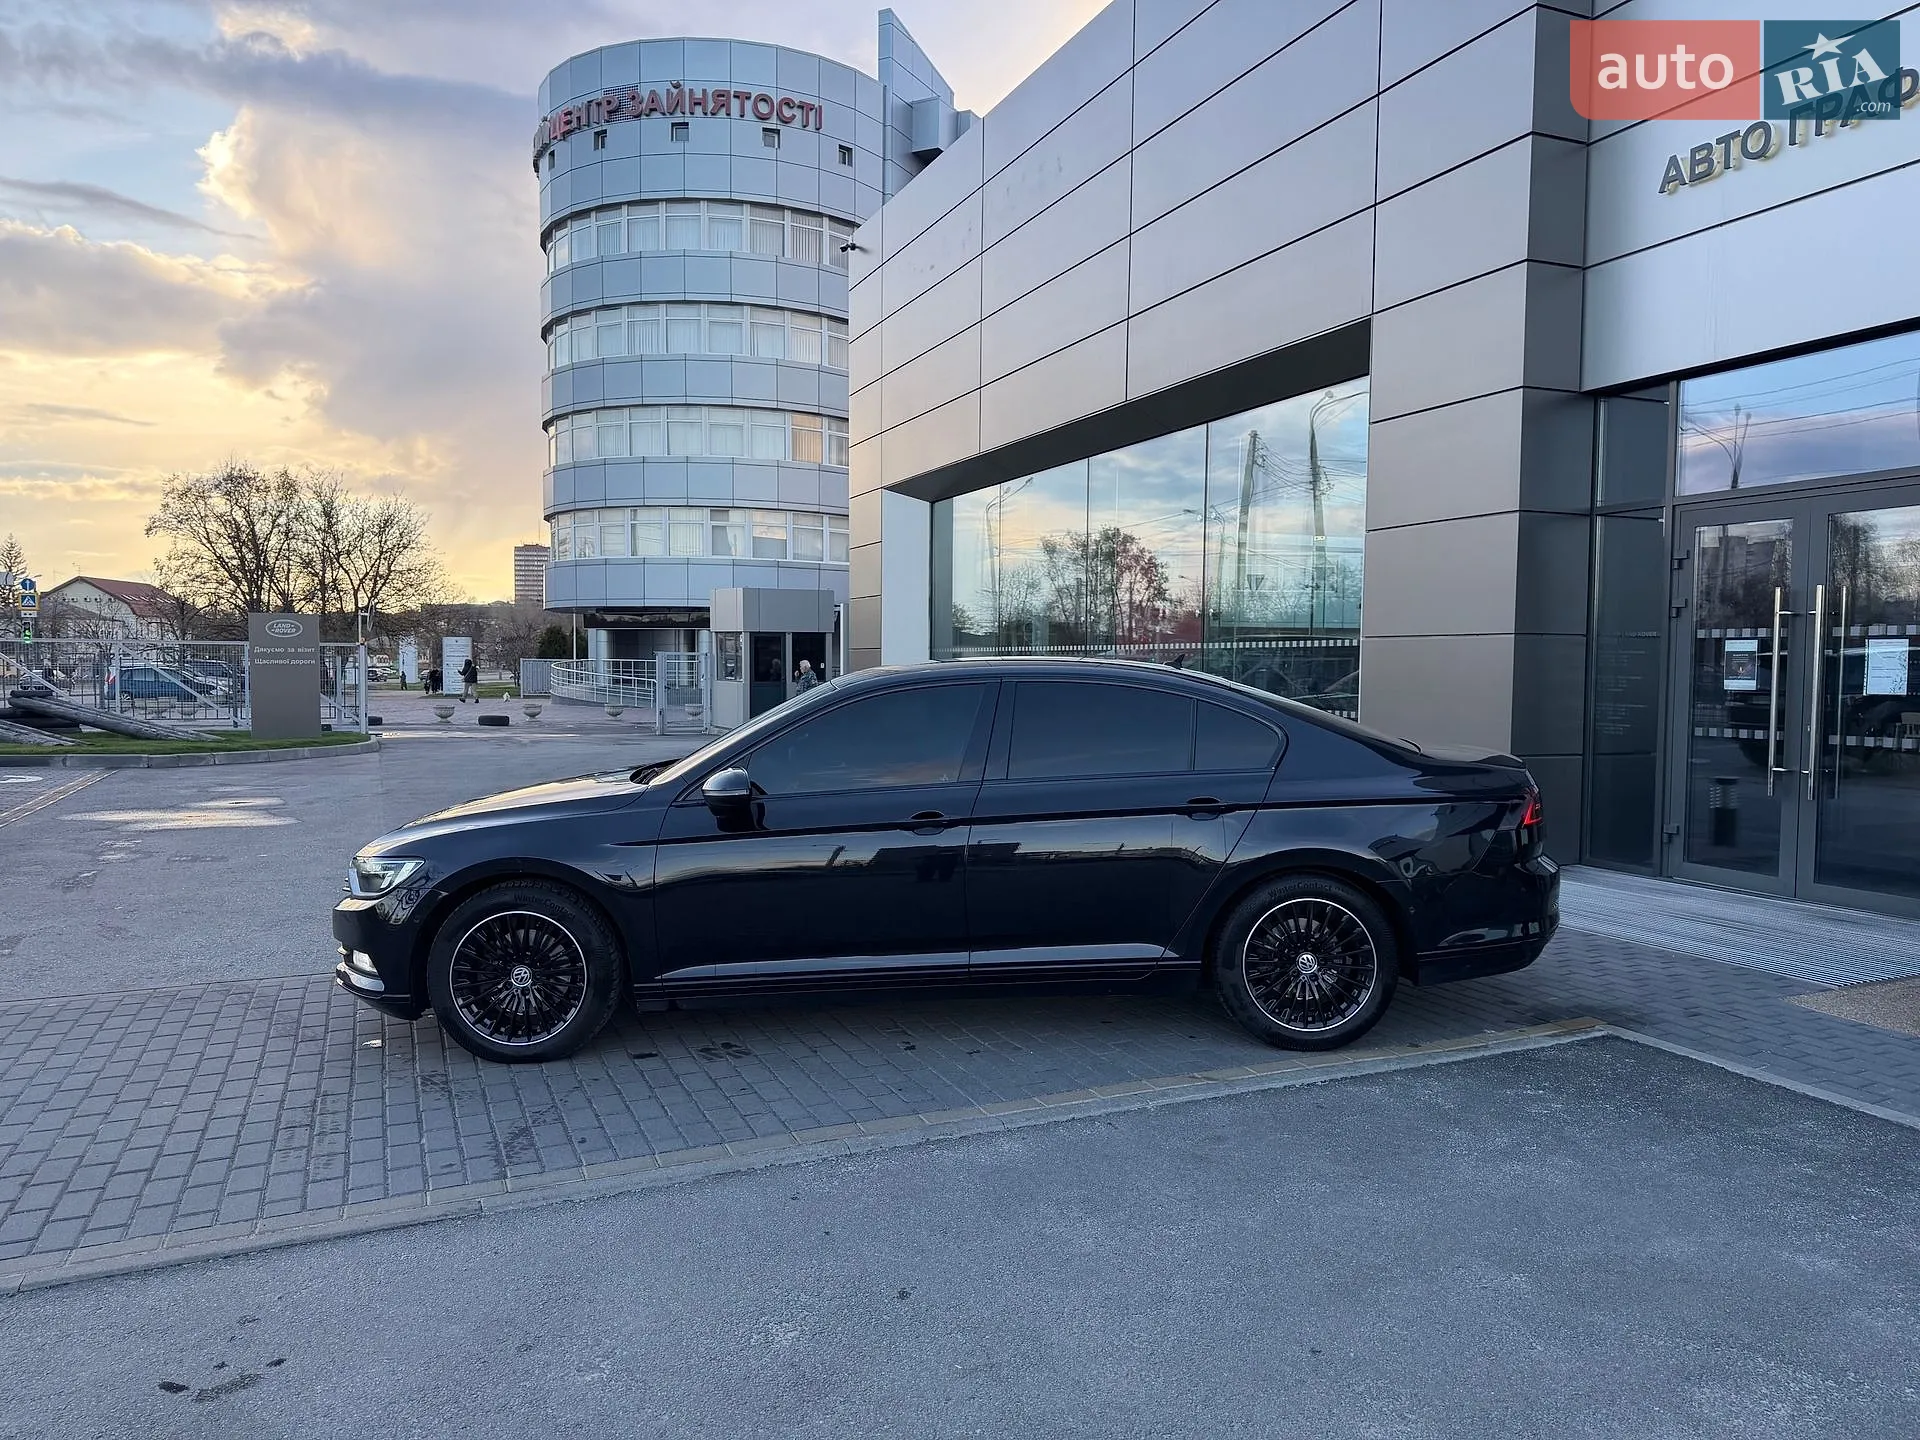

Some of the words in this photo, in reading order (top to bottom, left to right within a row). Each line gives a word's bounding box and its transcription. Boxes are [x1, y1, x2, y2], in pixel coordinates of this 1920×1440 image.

[549, 95, 619, 140] ЦЕНТР
[627, 80, 823, 131] ЗАЙНЯТОСТІ
[1657, 120, 1776, 194] АВТО
[1788, 66, 1920, 147] ГРАФ
